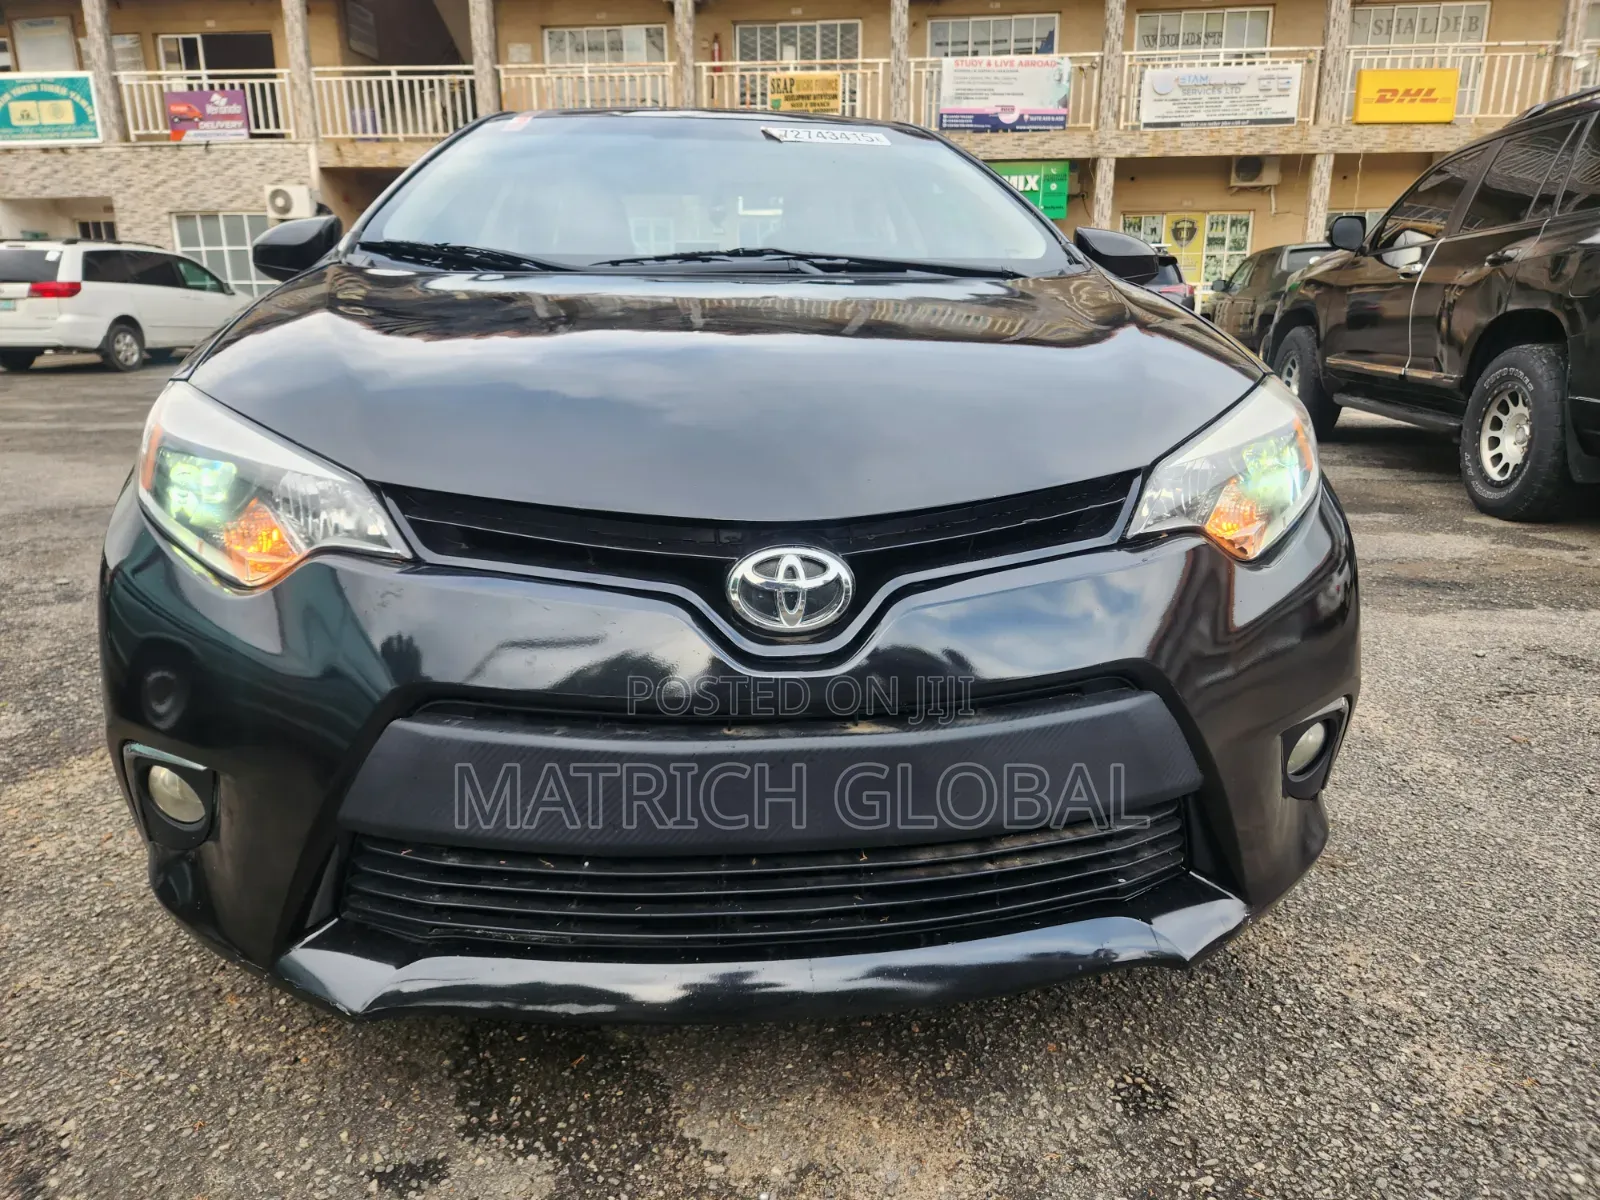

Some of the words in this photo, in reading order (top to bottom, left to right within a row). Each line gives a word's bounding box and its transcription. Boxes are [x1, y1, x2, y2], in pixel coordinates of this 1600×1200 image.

[1372, 15, 1480, 36] SHALDEB
[953, 59, 984, 68] STUDY
[985, 59, 993, 68] &
[994, 59, 1015, 68] LIVE
[1018, 59, 1057, 68] ABROAD
[770, 77, 795, 95] SEAP
[1181, 87, 1222, 96] SERVICES
[1225, 86, 1241, 95] LTD
[1374, 88, 1439, 104] DHL
[198, 120, 244, 130] DELIVERY
